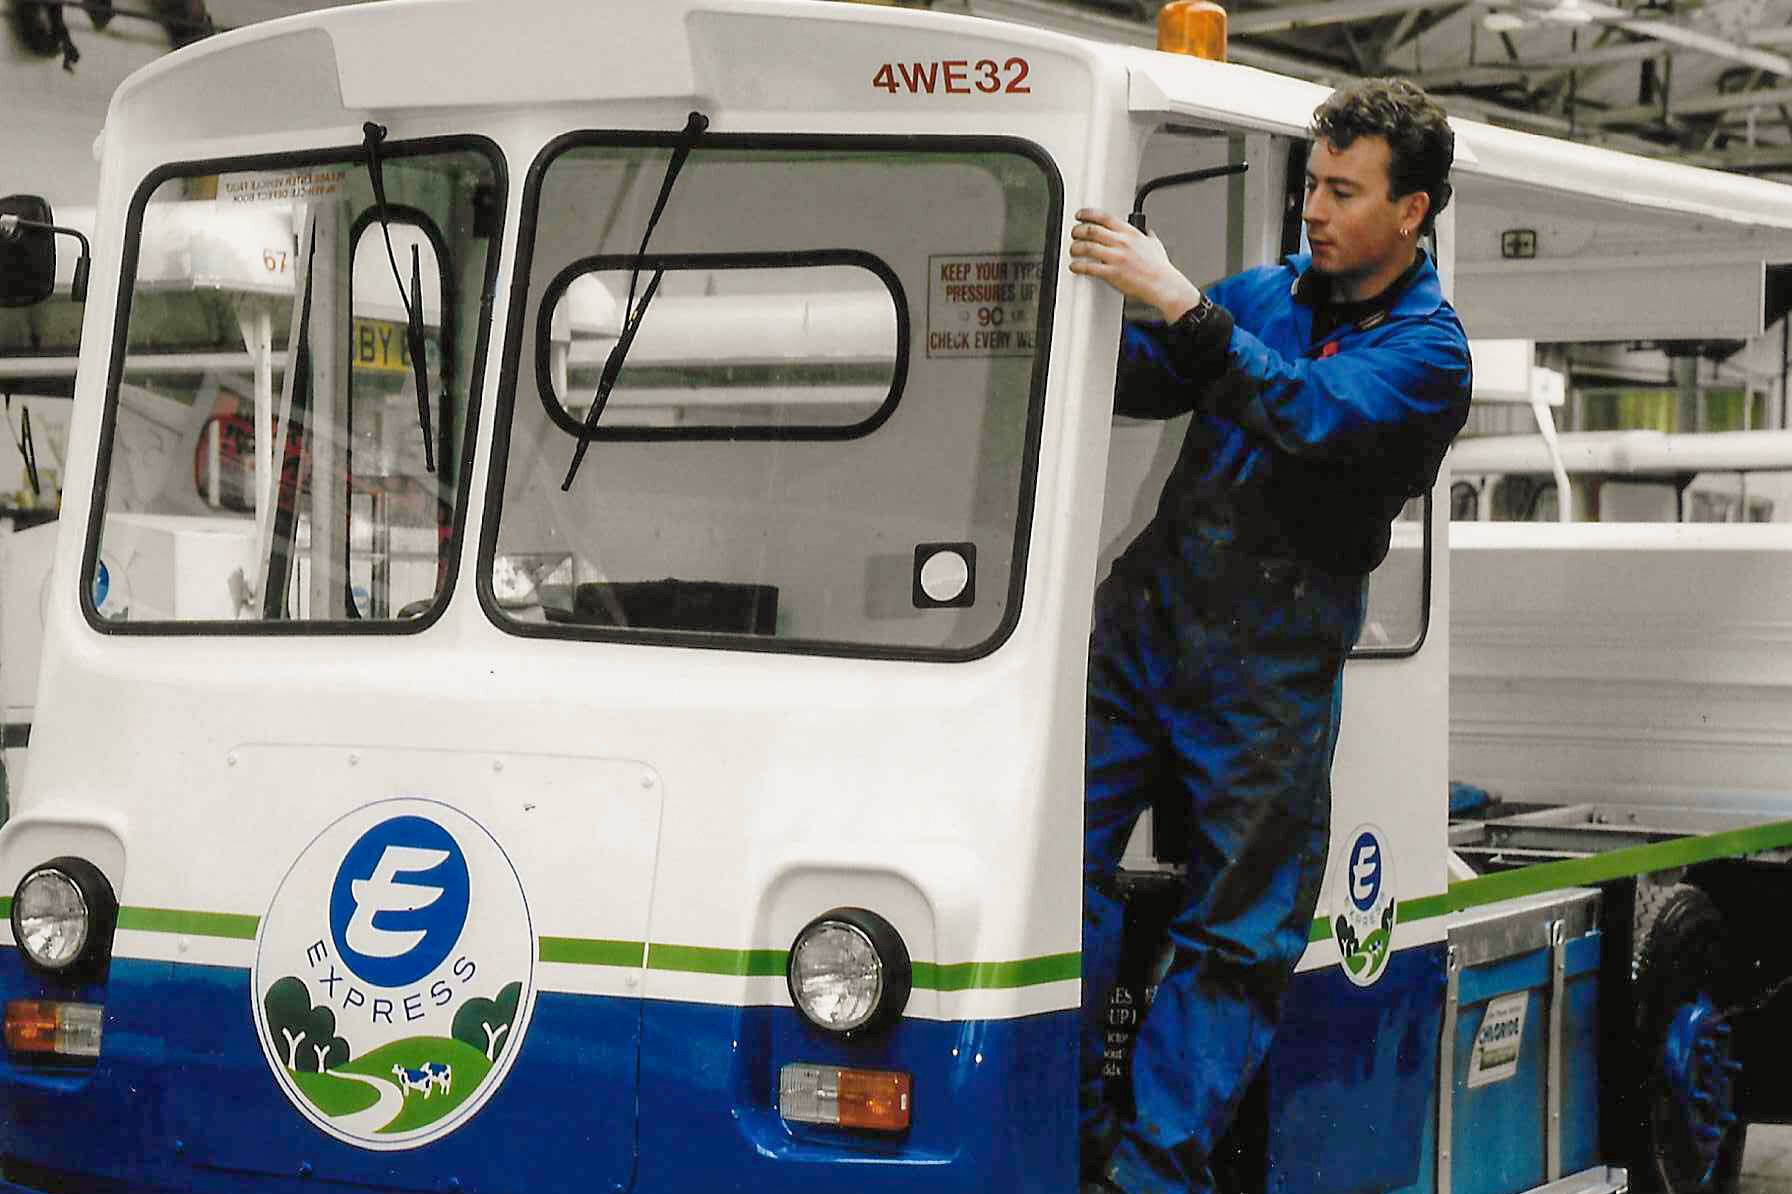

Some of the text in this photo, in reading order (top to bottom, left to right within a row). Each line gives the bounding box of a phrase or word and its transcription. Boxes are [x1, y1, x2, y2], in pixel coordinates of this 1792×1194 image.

[872, 56, 1031, 94] 4WE32
[263, 249, 287, 273] 67
[941, 263, 971, 281] KEEP
[976, 262, 1008, 281] YOUR
[945, 283, 1015, 303] PRESSURES
[977, 307, 1004, 327] 90
[929, 331, 969, 350] CHECK
[975, 330, 1011, 349] EVERY
[306, 939, 478, 1025] EXPRESS
